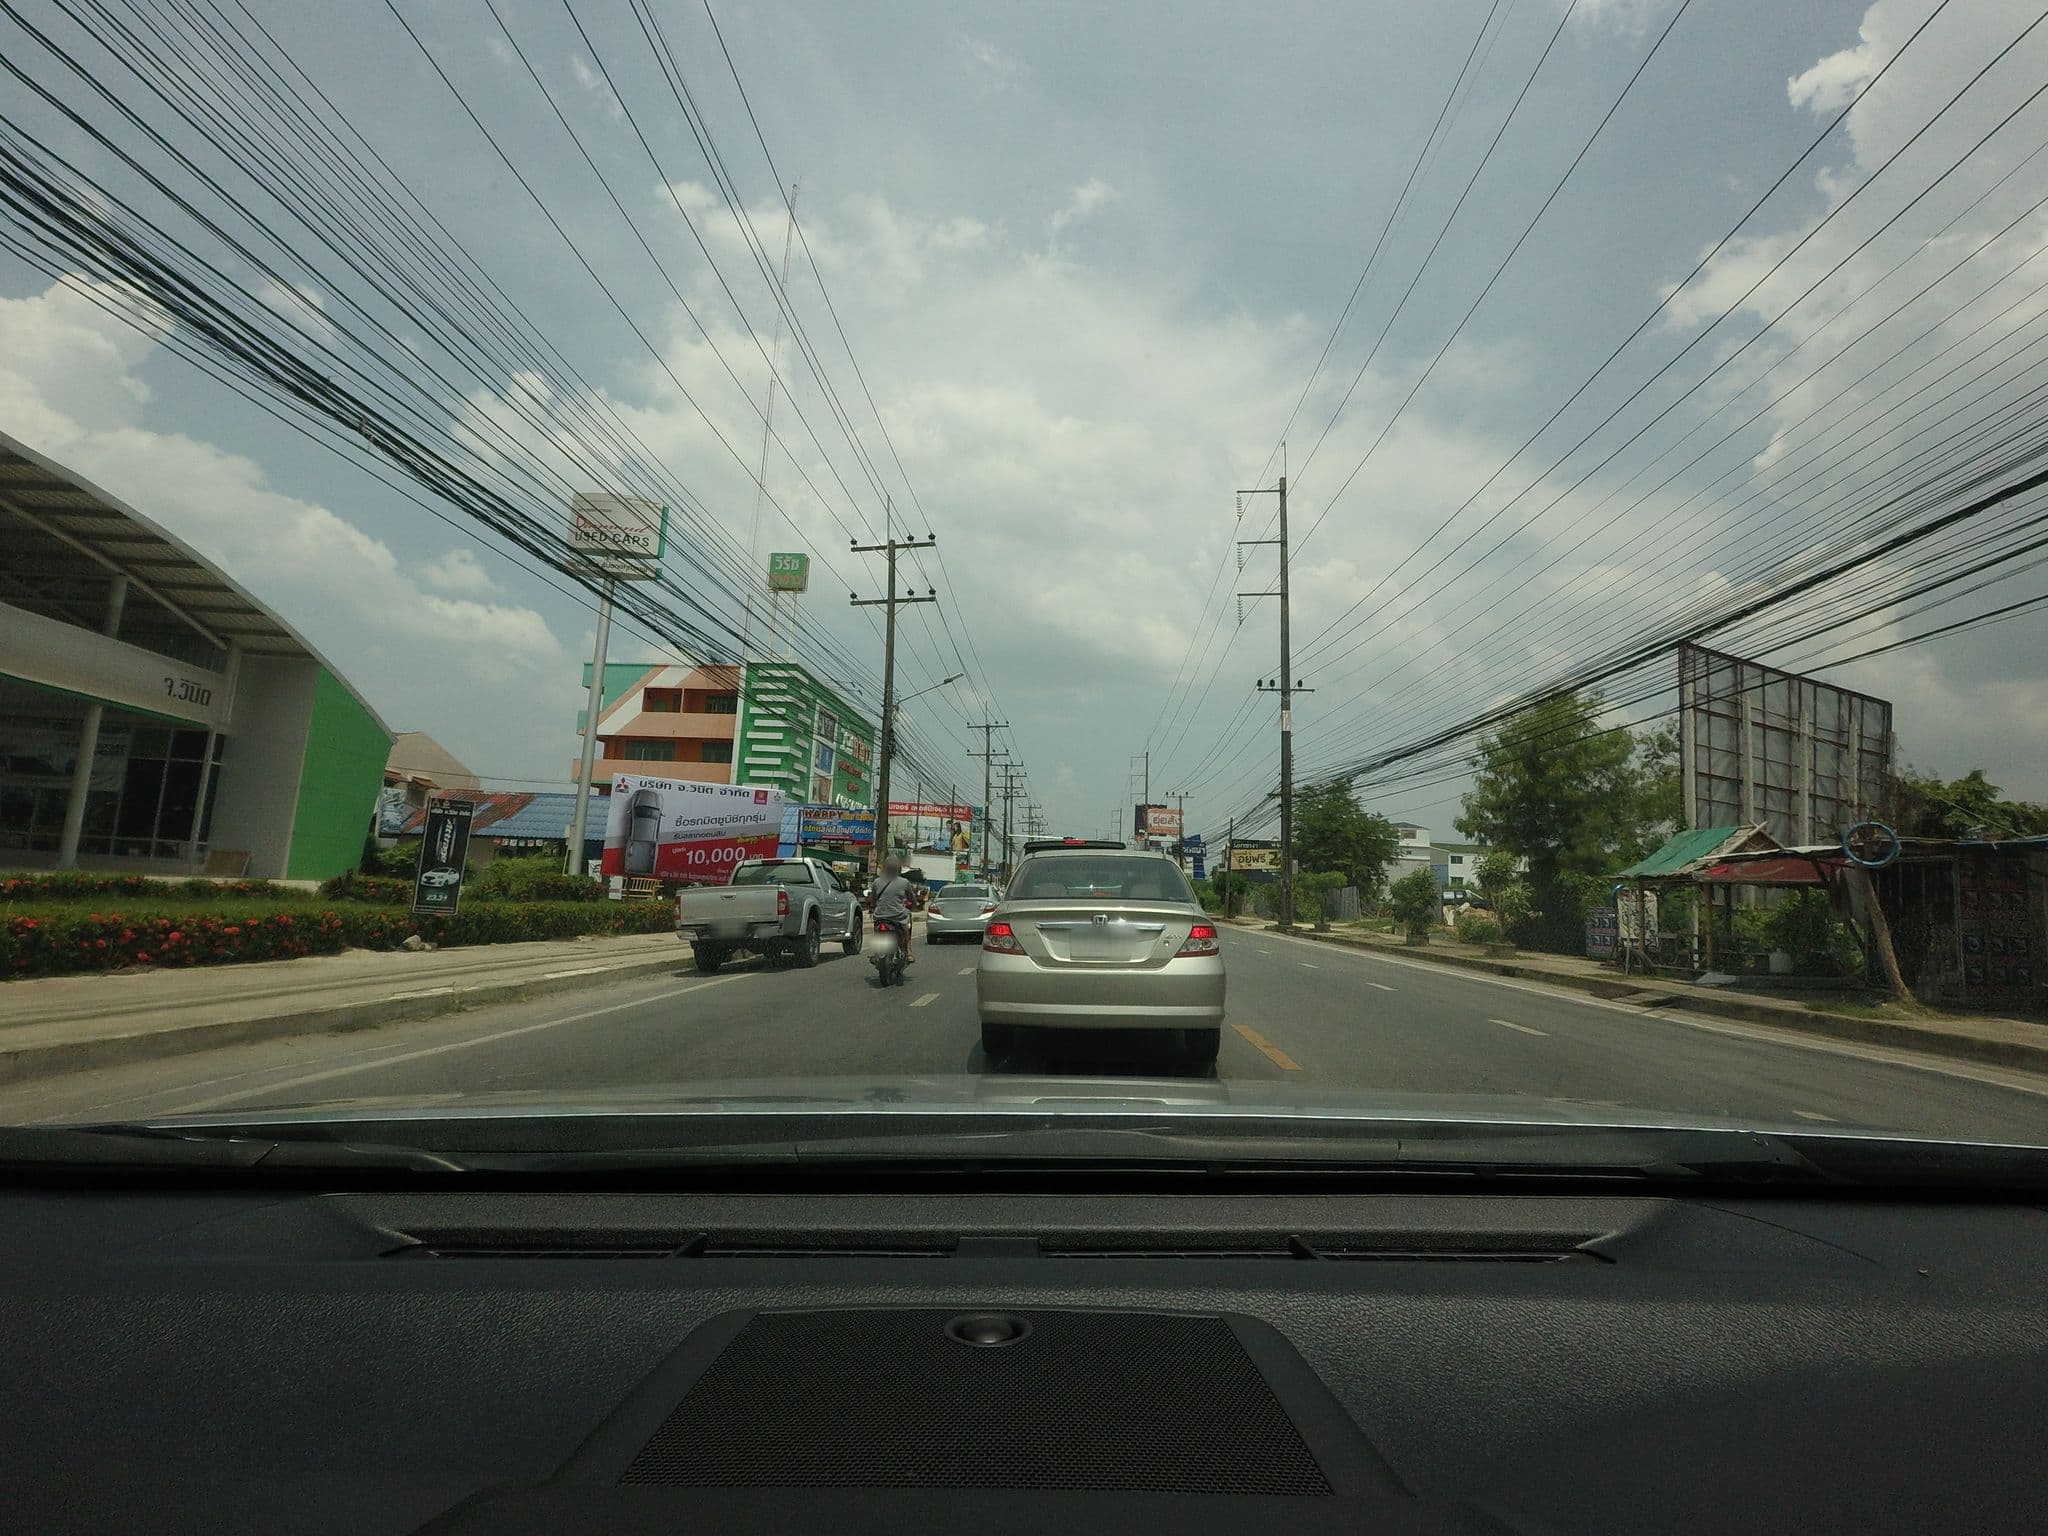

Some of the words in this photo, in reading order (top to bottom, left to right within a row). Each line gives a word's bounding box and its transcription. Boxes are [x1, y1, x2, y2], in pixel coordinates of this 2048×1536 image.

[575, 531, 608, 542] USED
[612, 533, 650, 547] CARS
[639, 779, 672, 791] บริษัท
[719, 787, 750, 798] จำกัด
[804, 809, 844, 820] HAPPY
[686, 846, 746, 866] 10,000
